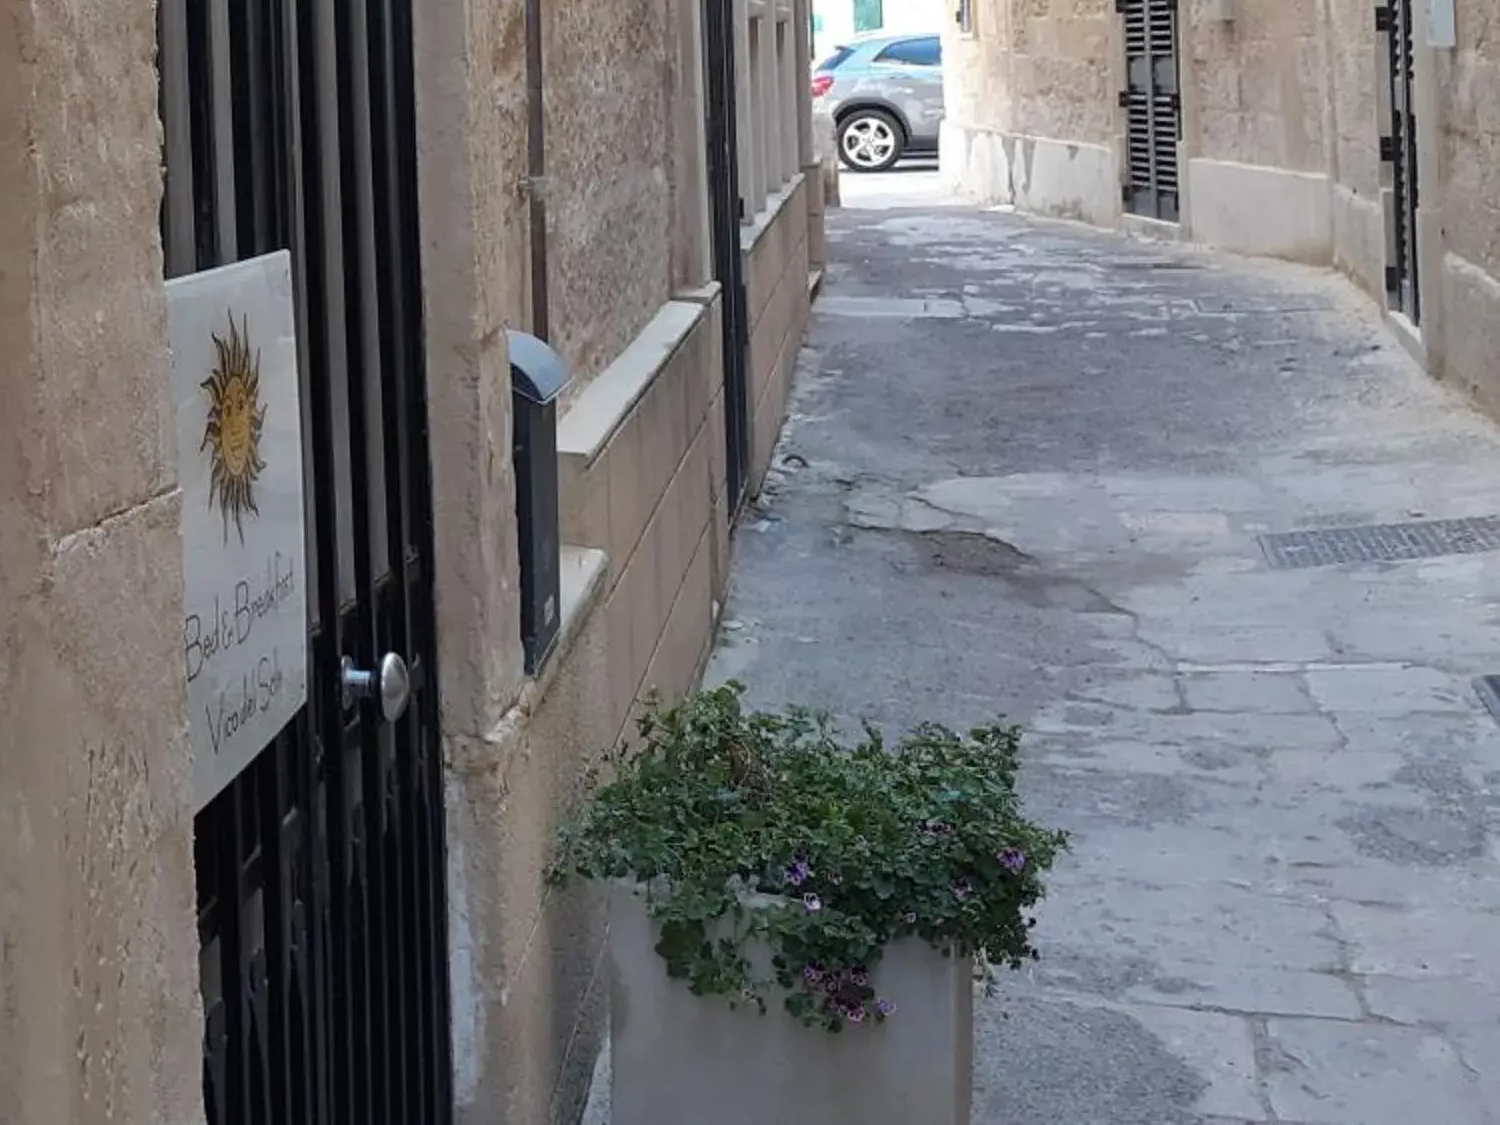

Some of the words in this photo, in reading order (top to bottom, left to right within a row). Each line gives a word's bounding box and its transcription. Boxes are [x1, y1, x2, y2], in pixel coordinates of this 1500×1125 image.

[184, 593, 219, 683] Bed
[234, 551, 295, 645] Breakfast
[205, 687, 239, 755] Vico
[240, 667, 257, 725] del
[257, 646, 283, 713] Sole
